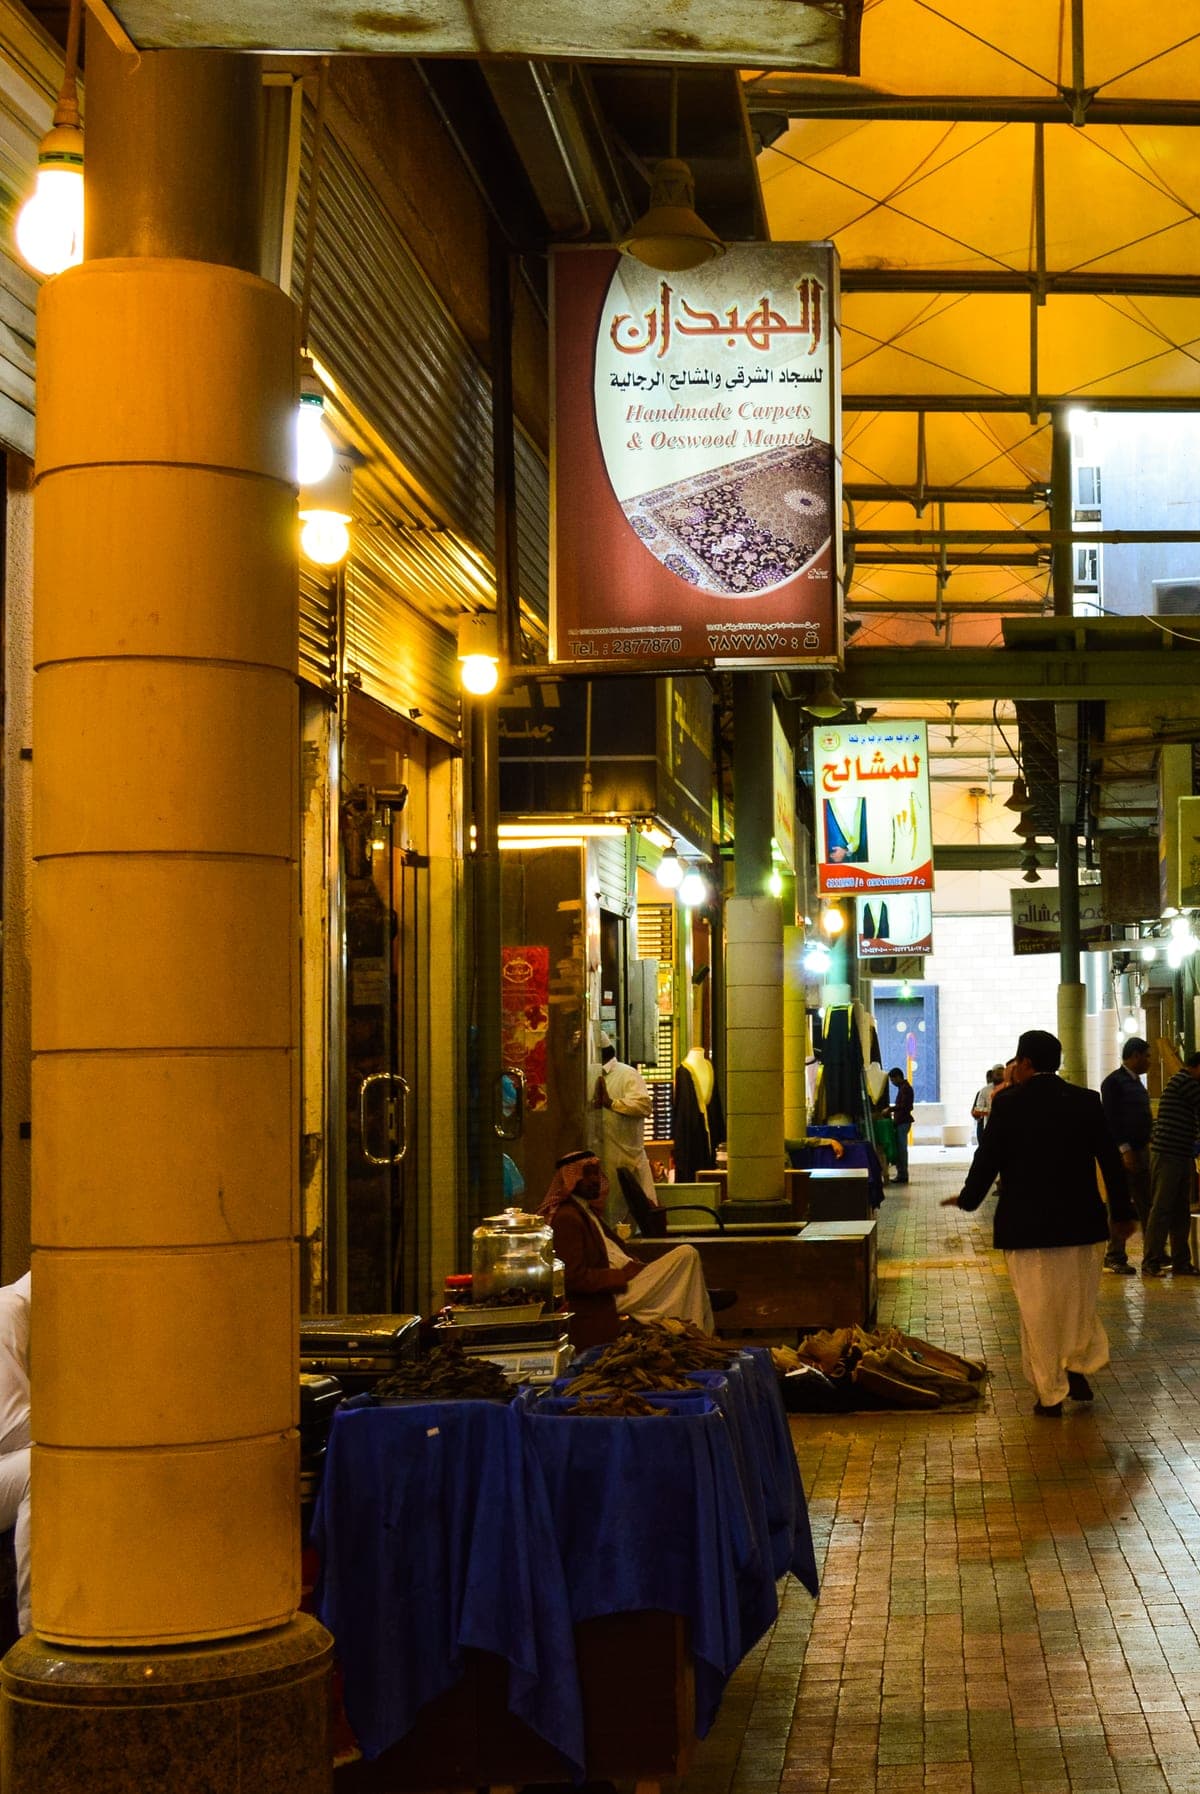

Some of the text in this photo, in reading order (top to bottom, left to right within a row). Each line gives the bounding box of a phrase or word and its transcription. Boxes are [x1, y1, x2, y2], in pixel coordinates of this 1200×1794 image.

[610, 277, 824, 359] الهبدان
[609, 366, 823, 392] للسجاد الشرقي والمشالح الرجالية
[625, 401, 812, 424] Handmade Carpets
[626, 431, 643, 450] &
[744, 428, 813, 448] Mantel
[570, 640, 599, 657] Tel.
[612, 638, 682, 655] 2877870
[708, 633, 788, 651] ٢٨٧٧٨٧٠
[821, 749, 921, 792] للمشالح
